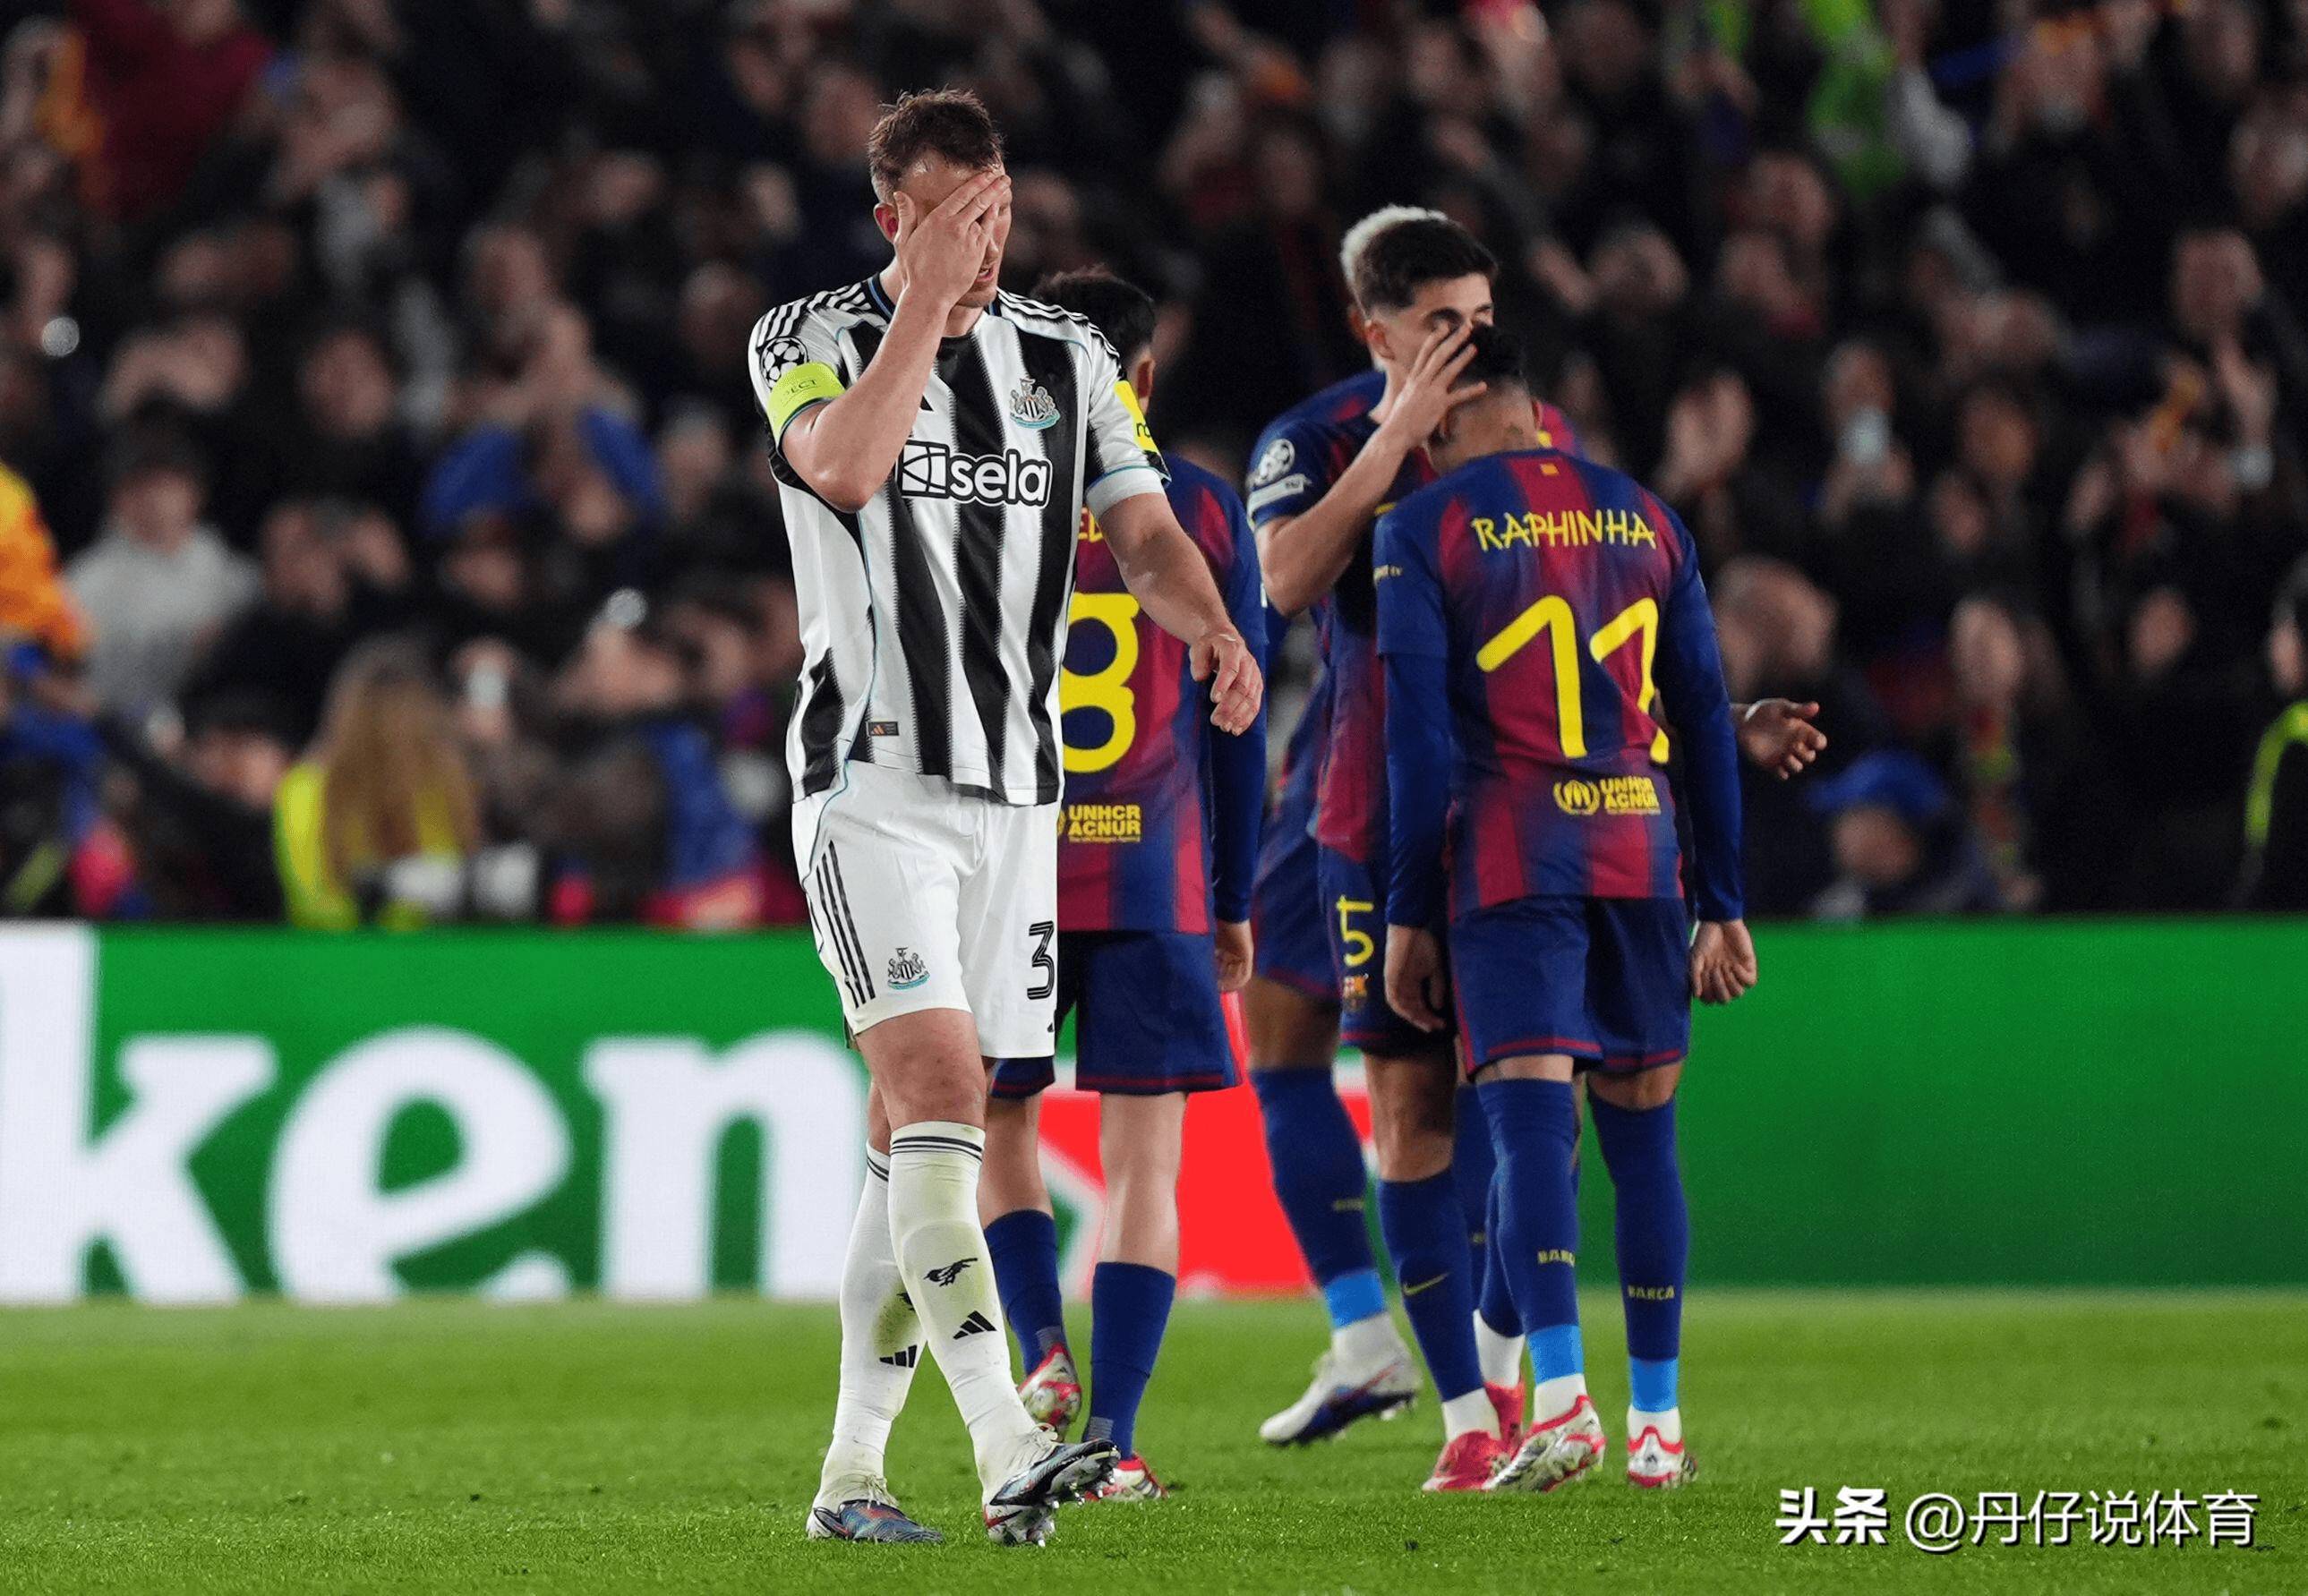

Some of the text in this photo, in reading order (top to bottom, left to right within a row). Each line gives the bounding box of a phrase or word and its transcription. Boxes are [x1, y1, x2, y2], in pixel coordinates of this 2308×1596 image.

[949, 453, 1047, 502] sela
[1471, 508, 1656, 551] RAPHINHA
[1059, 592, 1140, 773] 8
[1476, 594, 1669, 764] 11
[1068, 804, 1141, 820] UNHCR
[1068, 820, 1141, 836] ACNUR
[1027, 920, 1056, 1000] 3
[1337, 895, 1374, 966] 5
